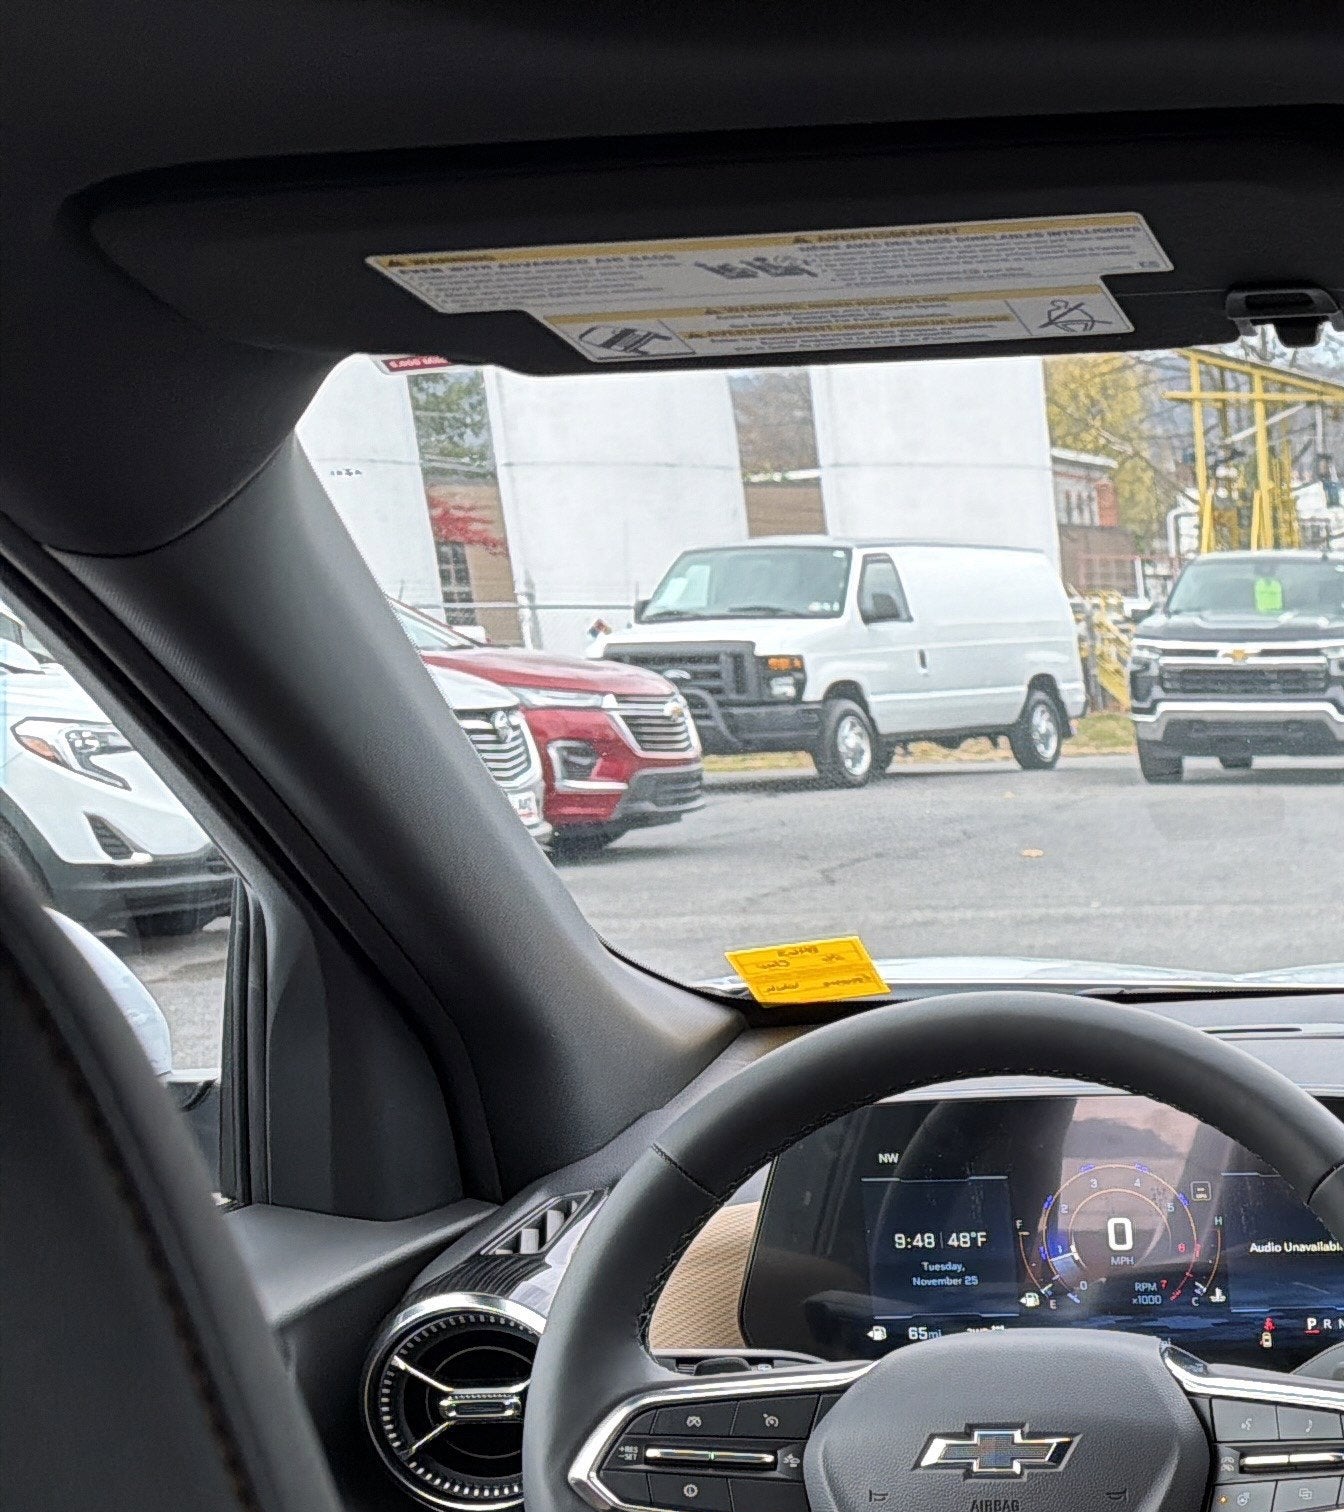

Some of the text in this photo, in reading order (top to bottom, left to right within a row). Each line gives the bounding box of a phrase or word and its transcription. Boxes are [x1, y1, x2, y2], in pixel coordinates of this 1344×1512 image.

[878, 1153, 900, 1164] NW
[1090, 1178, 1141, 1188] 3 4
[1060, 1202, 1175, 1214] 2 5
[1015, 1219, 1023, 1229] F
[1214, 1216, 1223, 1226] H
[1107, 1217, 1134, 1251] 0
[894, 1231, 987, 1249] 9:48 48°F
[1249, 1240, 1344, 1253] Audio Unavailabl
[921, 1261, 966, 1272] Tuesday,
[1110, 1256, 1135, 1266] MPH
[912, 1275, 979, 1286] November 25
[1079, 1279, 1088, 1291] 0
[1160, 1279, 1168, 1290] 7
[1134, 1281, 1158, 1292] RPM
[1049, 1299, 1057, 1310] E
[1131, 1294, 1162, 1305] x1000
[1191, 1297, 1200, 1307] C
[1306, 1317, 1318, 1331] P
[1323, 1318, 1333, 1329] R
[970, 1499, 1020, 1512] AIRBAG
